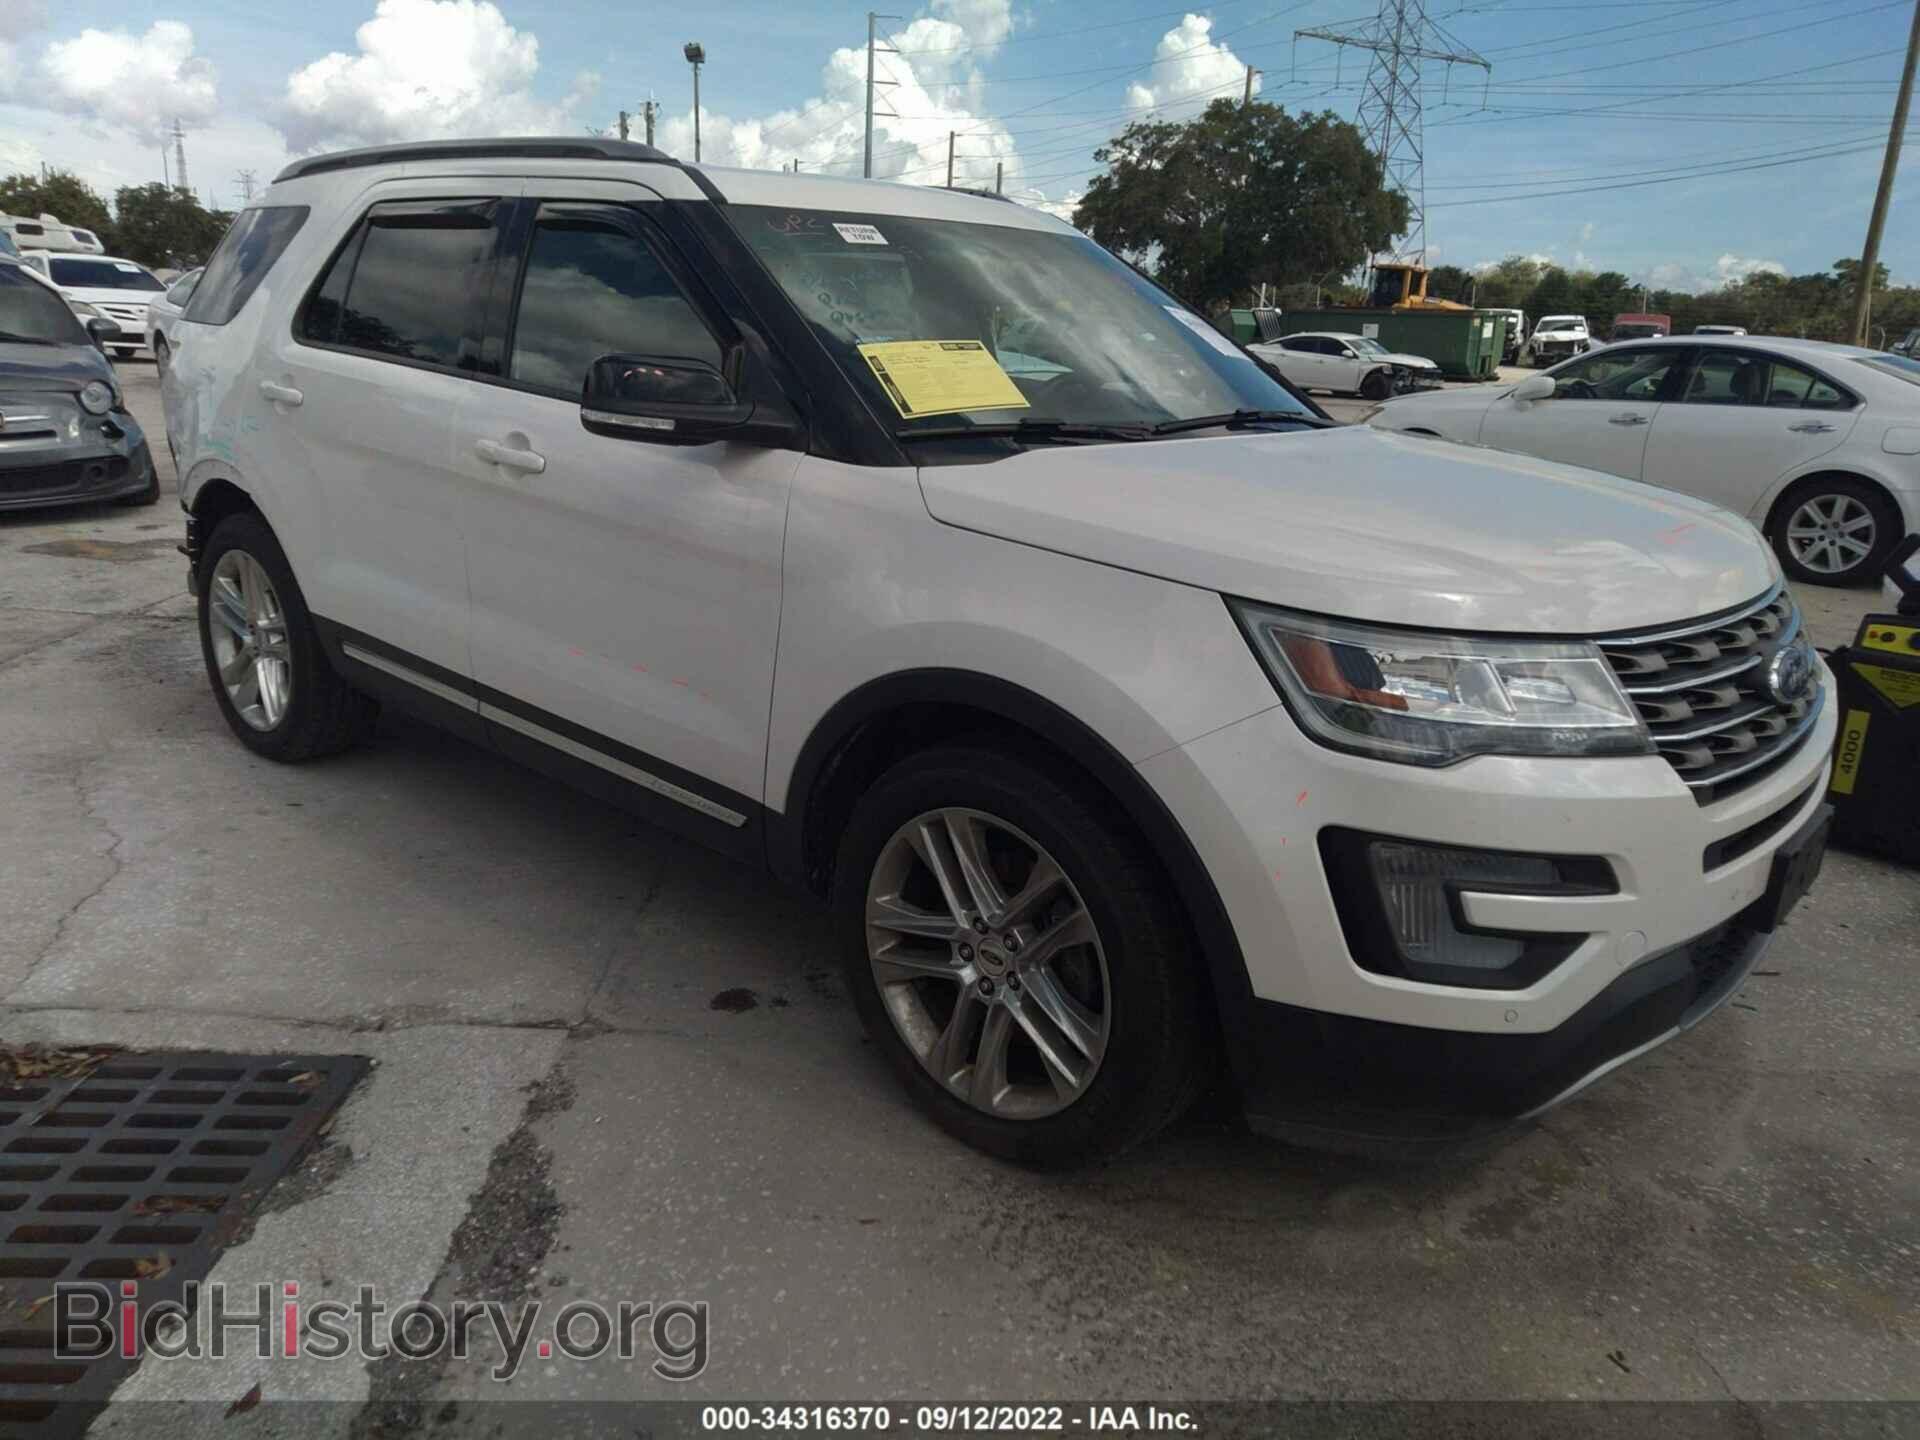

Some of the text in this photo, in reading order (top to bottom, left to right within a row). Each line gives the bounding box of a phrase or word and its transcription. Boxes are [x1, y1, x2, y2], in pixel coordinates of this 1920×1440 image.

[838, 226, 878, 235] RETURN
[852, 233, 876, 241] TOW
[1840, 729, 1861, 774] 4000
